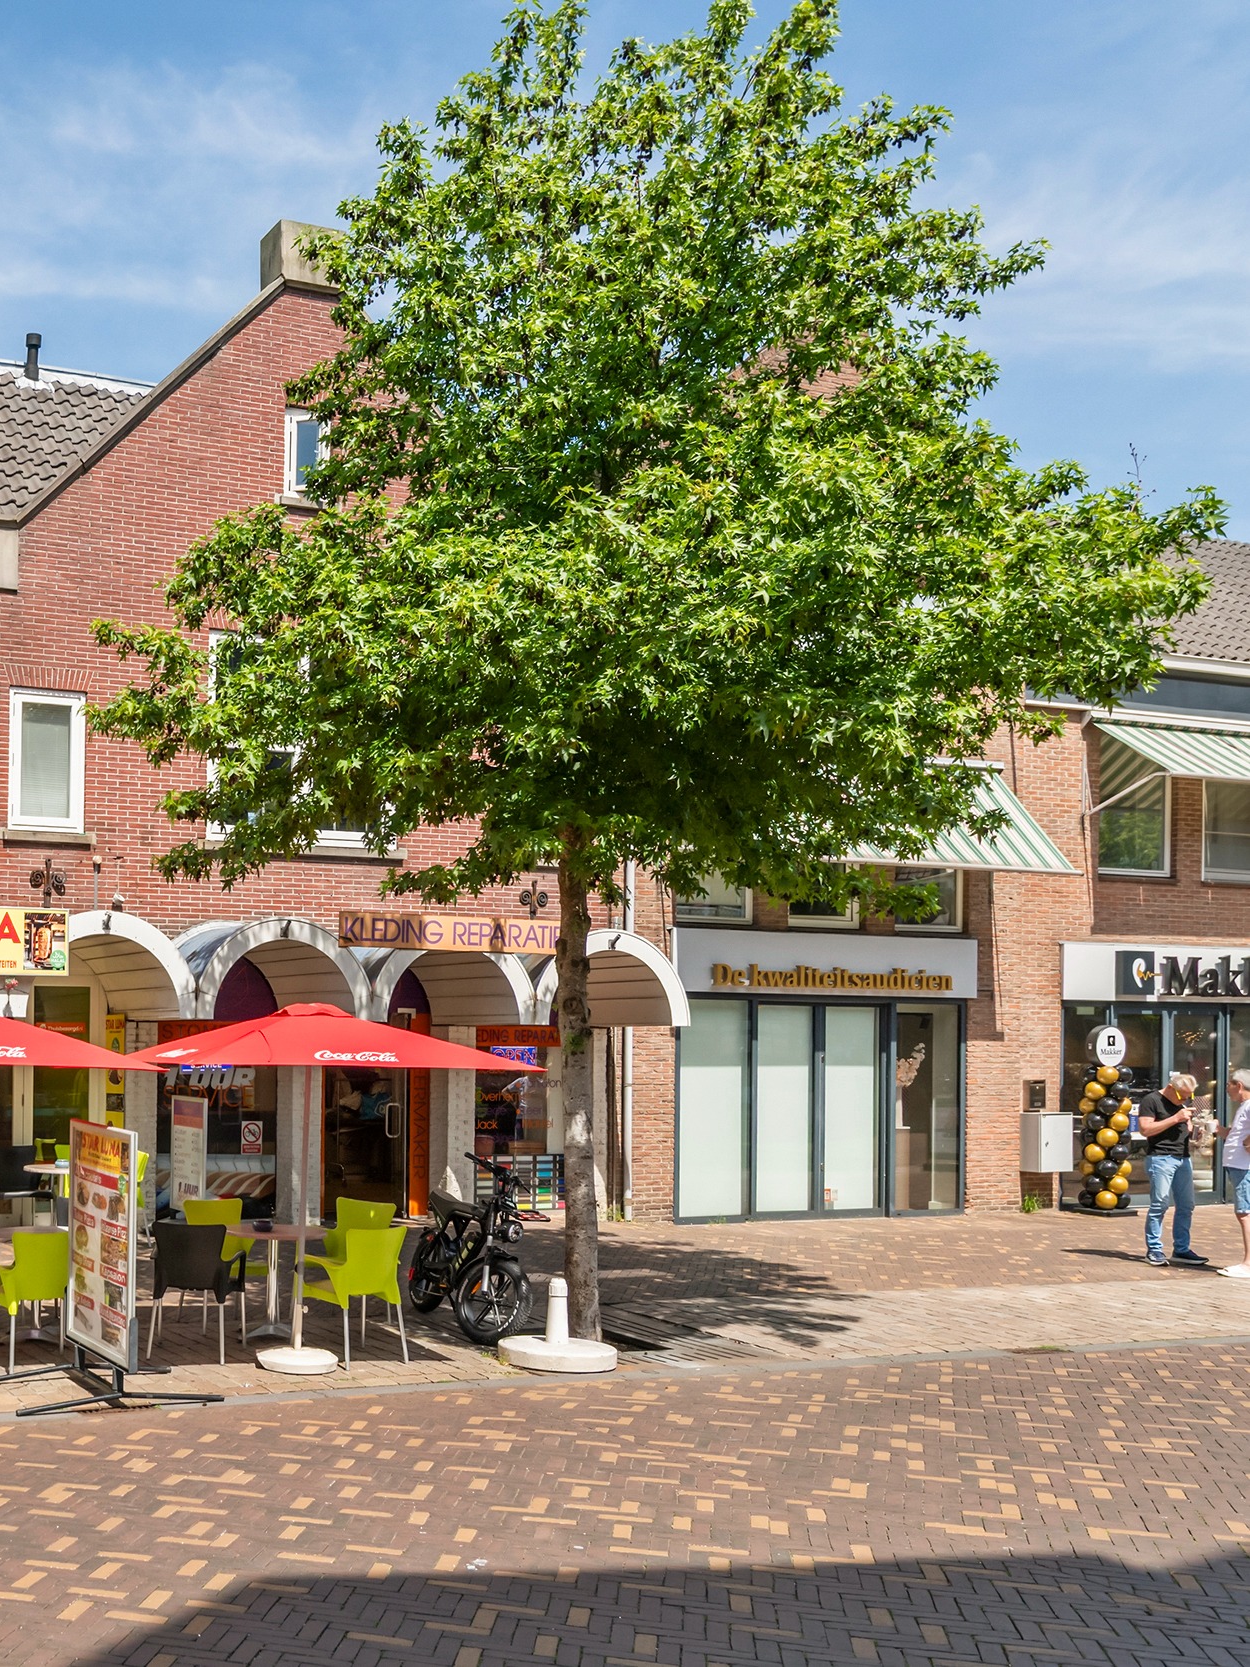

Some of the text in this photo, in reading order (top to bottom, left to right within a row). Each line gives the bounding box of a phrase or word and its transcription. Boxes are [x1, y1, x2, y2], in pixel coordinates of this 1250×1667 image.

[344, 916, 443, 945] KLEDING
[711, 963, 953, 991] De kwaliteitsaudicien
[313, 1050, 399, 1062] Coca-Cola
[1099, 1048, 1123, 1056] Makker
[475, 1090, 521, 1102] Overhem
[475, 1119, 498, 1129] Jack
[82, 1133, 120, 1157] STAR LUNA
